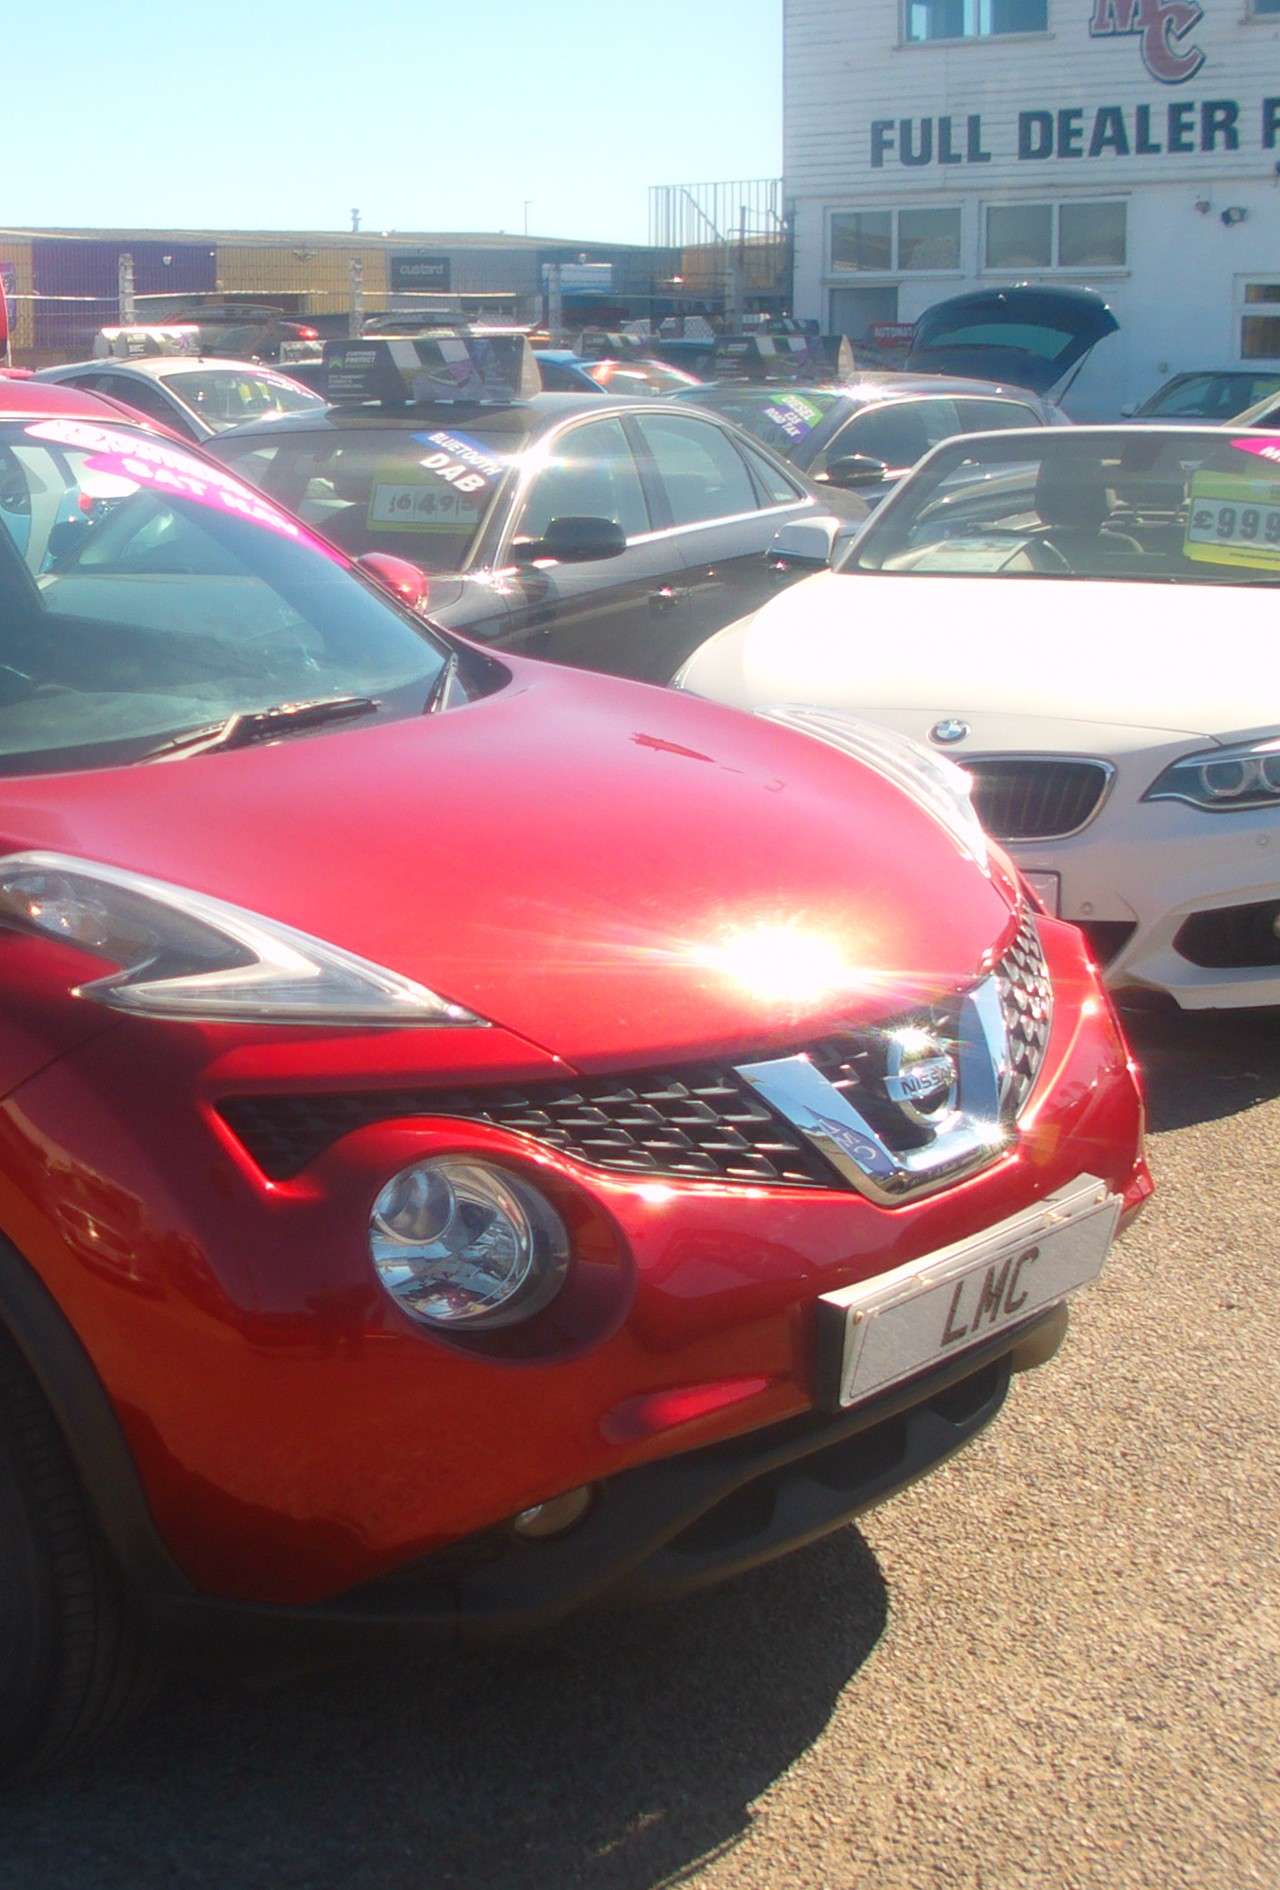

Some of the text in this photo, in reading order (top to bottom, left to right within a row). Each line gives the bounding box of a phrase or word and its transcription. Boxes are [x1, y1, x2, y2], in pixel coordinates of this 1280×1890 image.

[871, 114, 991, 168] FULL
[1018, 99, 1240, 161] DEALER
[419, 452, 487, 493] DAB
[428, 432, 504, 476] BLUETOOTH
[940, 1246, 1040, 1348] LMC
